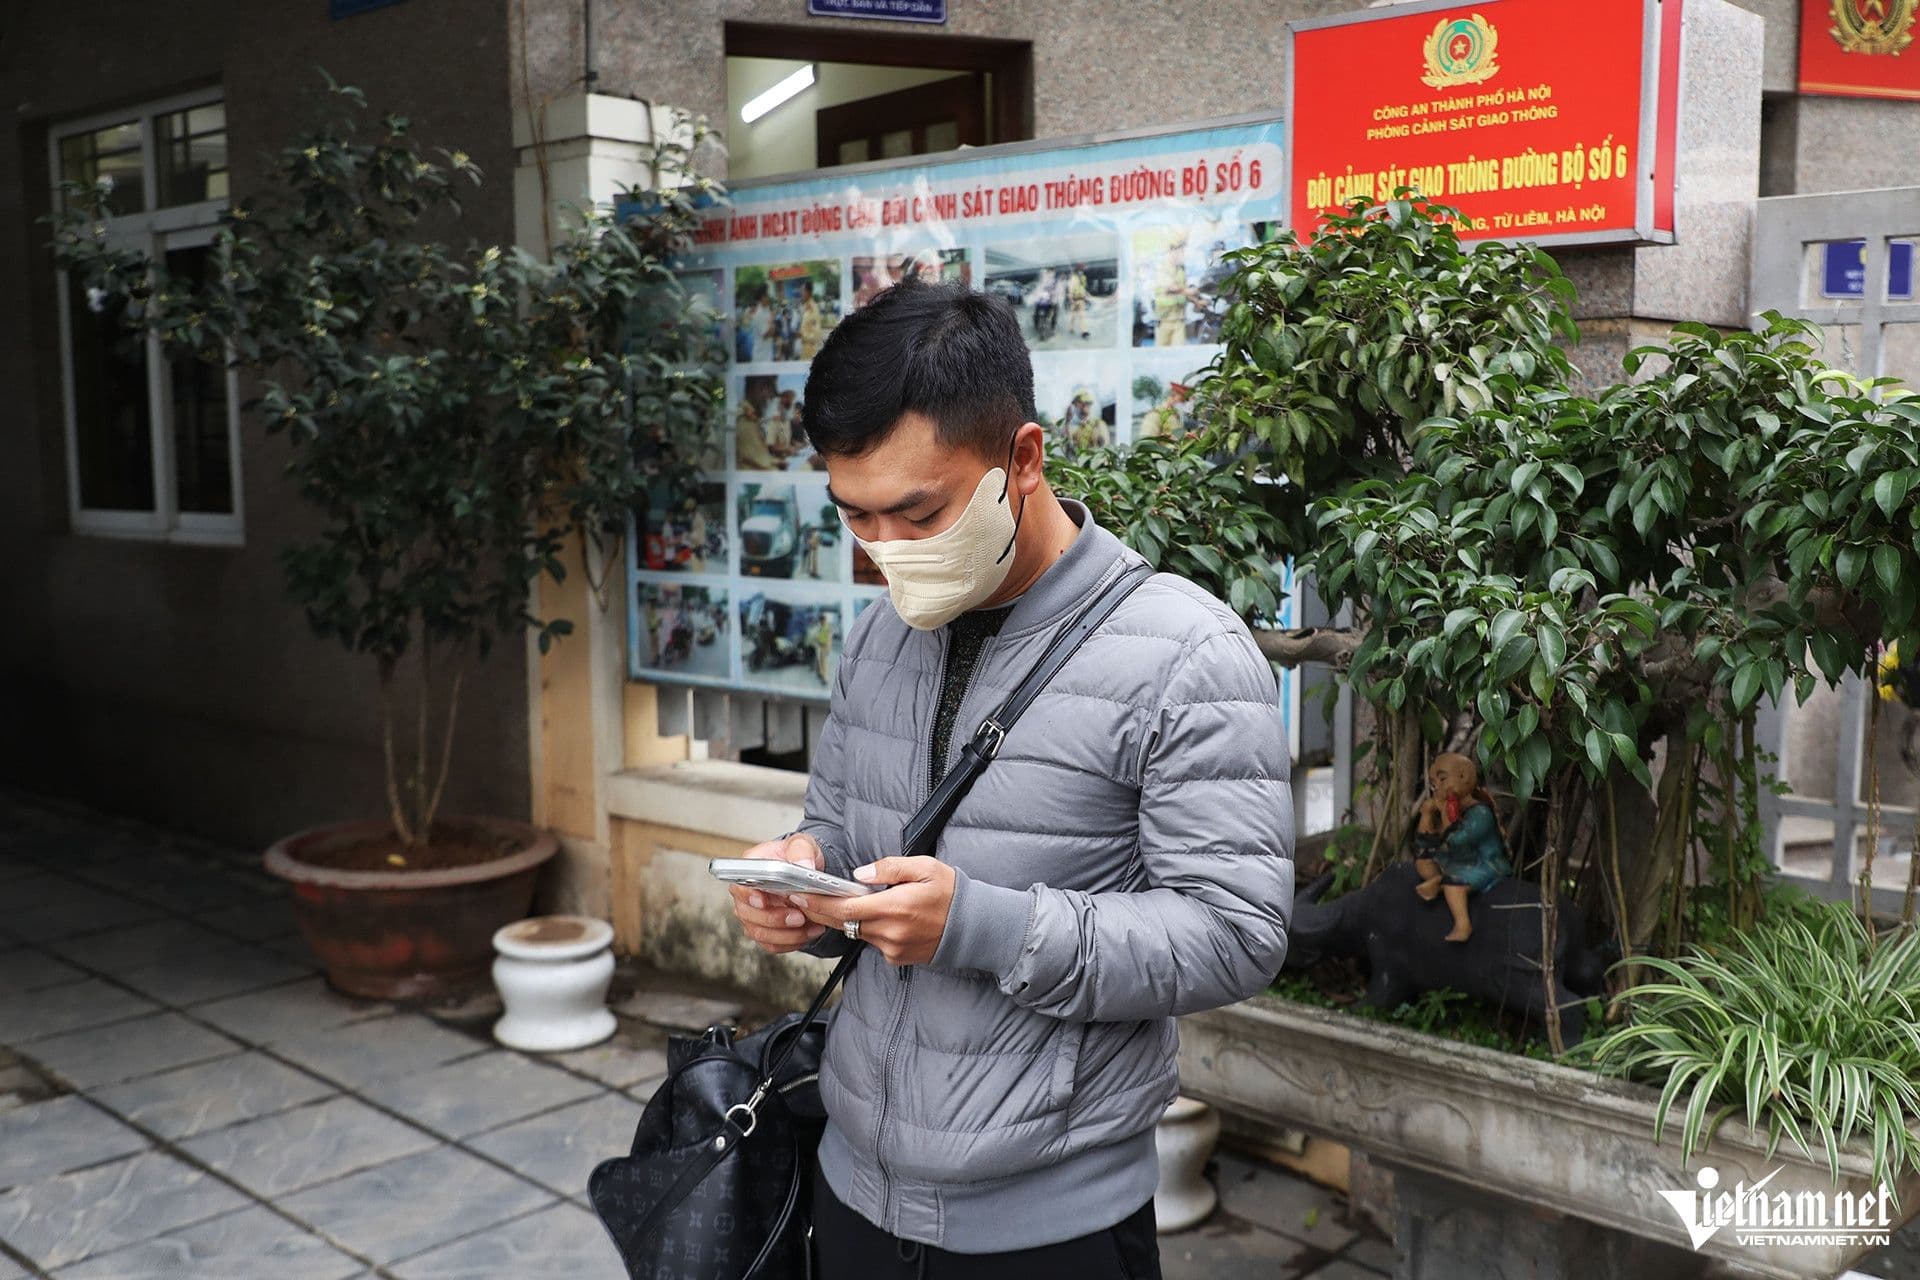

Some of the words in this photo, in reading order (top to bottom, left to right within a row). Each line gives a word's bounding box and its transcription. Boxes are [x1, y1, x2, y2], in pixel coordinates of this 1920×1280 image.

[1373, 105, 1408, 121] CÔNG
[1411, 103, 1428, 116] AN
[1431, 96, 1474, 113] THÀNH
[1477, 88, 1505, 108] PHỐ
[1507, 87, 1525, 103] HÀ
[1528, 83, 1552, 101] NỘI
[1367, 123, 1410, 141] PHÒNG
[1412, 117, 1447, 136] CẢNH
[1449, 114, 1475, 131] SÁT
[1477, 111, 1509, 127] GIAO
[1511, 105, 1558, 123] THÔNG
[1307, 171, 1332, 215] ĐỘI
[1334, 164, 1375, 207] CẢNH
[1377, 163, 1406, 202] SÁT
[1408, 165, 1444, 199] GIAO
[1447, 154, 1499, 195] THÔNG
[1502, 147, 1558, 190] ĐƯỜNG
[1561, 142, 1585, 190] BỘ
[1588, 133, 1614, 181] SỐ
[1615, 144, 1627, 178] 6
[729, 209, 758, 241] ẢNH
[801, 202, 842, 239] ĐỘNG
[962, 184, 994, 218] SÁT
[999, 184, 1038, 214] GIAO
[1045, 174, 1104, 209] THÔNG
[1110, 164, 1175, 204] ĐƯỜNG
[1182, 159, 1208, 202] BỘ
[1215, 150, 1242, 193] SỐ
[1249, 159, 1262, 189] 6
[1556, 206, 1576, 223] HÀ
[1580, 204, 1605, 221] NỘI
